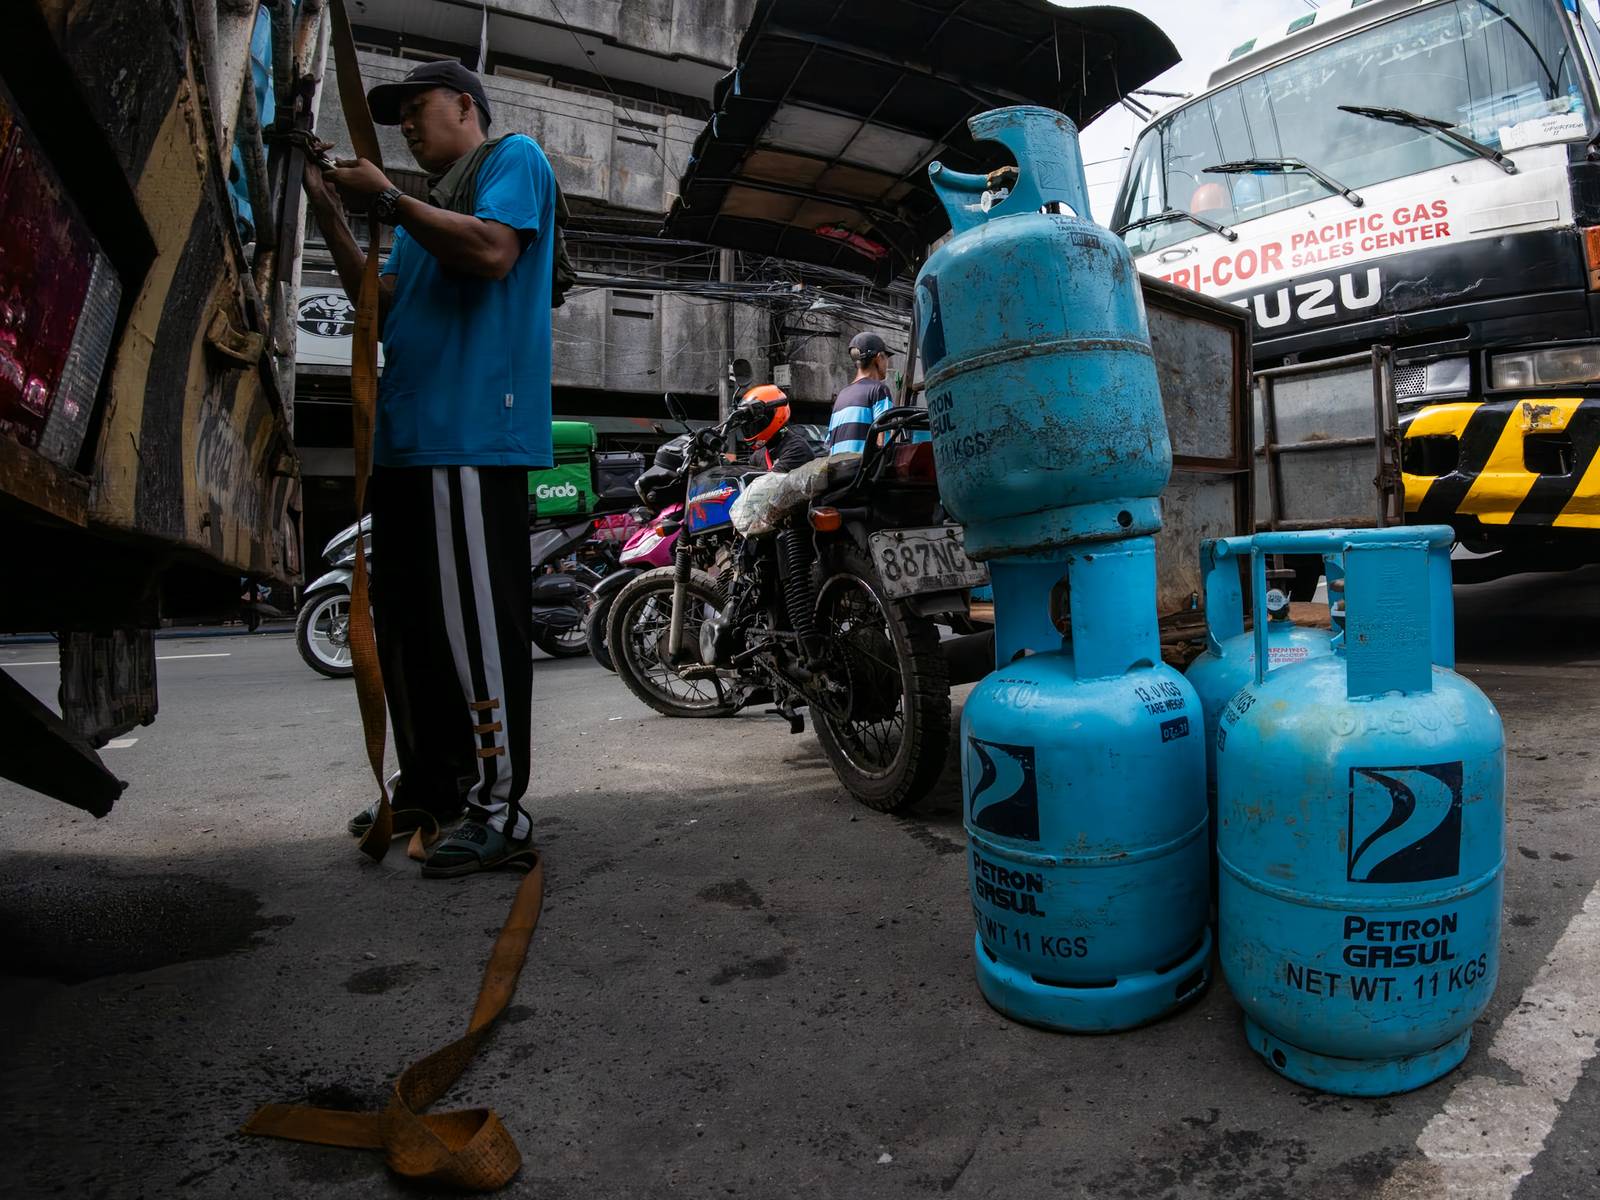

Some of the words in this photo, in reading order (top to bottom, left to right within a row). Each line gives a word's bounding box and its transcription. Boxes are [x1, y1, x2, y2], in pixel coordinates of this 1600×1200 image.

[1291, 213, 1384, 251] PACIFIC
[1392, 200, 1448, 226] GAS
[1292, 241, 1354, 268] SALES
[1361, 222, 1451, 252] CENTER
[1230, 267, 1382, 328] UZU
[536, 481, 577, 499] Grab
[1135, 686, 1161, 703] 13.0
[1157, 682, 1181, 697] KGS
[1145, 702, 1166, 716] TARE
[973, 850, 1043, 893] PETRON
[976, 877, 1045, 917] GASUL
[1014, 929, 1031, 953] 11
[1041, 936, 1088, 958] KGS
[1343, 912, 1457, 941] PETRON
[1343, 939, 1456, 968] GASUL
[1287, 962, 1341, 997] NET
[1350, 976, 1402, 1002] WT.
[1413, 972, 1439, 999] 11
[1448, 953, 1486, 992] KGS
